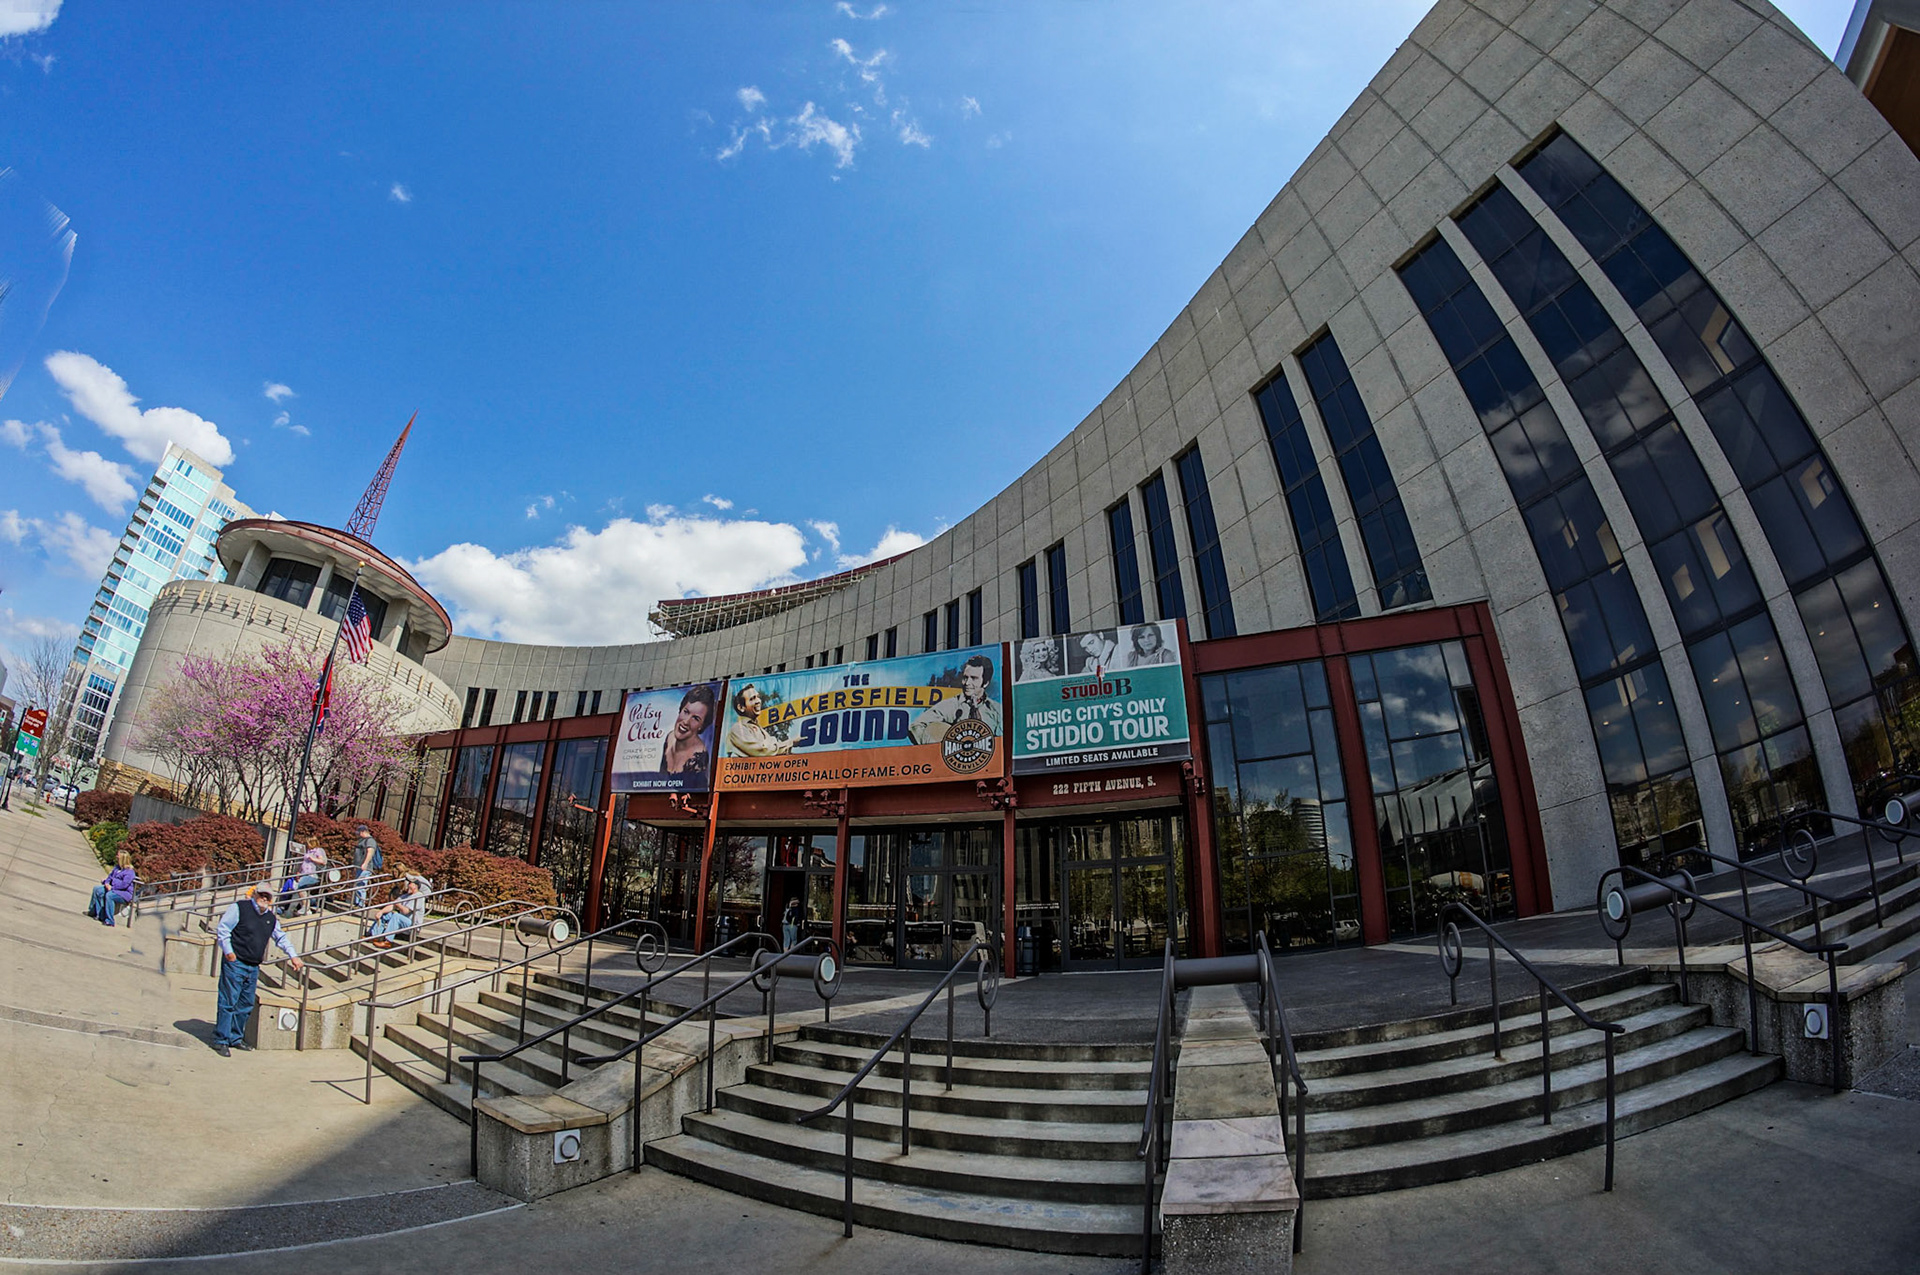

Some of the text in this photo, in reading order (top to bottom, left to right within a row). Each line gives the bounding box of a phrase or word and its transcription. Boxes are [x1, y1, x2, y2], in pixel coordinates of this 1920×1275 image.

[843, 673, 870, 687] THE
[1061, 677, 1132, 699] STUDIO B
[767, 688, 943, 724] BAKERSFIELD
[1026, 698, 1166, 728] MUSIC CITY'S ONLY
[629, 703, 662, 730] Patsy
[627, 722, 664, 742] Cline
[800, 709, 910, 748] SOUND
[949, 722, 989, 738] COUNTRY
[956, 729, 981, 741] MUSIC
[1026, 715, 1170, 750] STUDIO TOUR
[944, 740, 962, 756] HALL
[973, 736, 992, 752] FAME
[725, 758, 809, 771] EXHIBIT NOW OPEN
[948, 754, 988, 770] NASHVILLE
[955, 751, 981, 762] MUSEUM
[1046, 748, 1159, 767] LIMITED SEATS AVAILABLE
[633, 779, 684, 788] EXHIBIT NOW OPEN
[1052, 776, 1156, 795] 222 FIFTH AVENUE, S.
